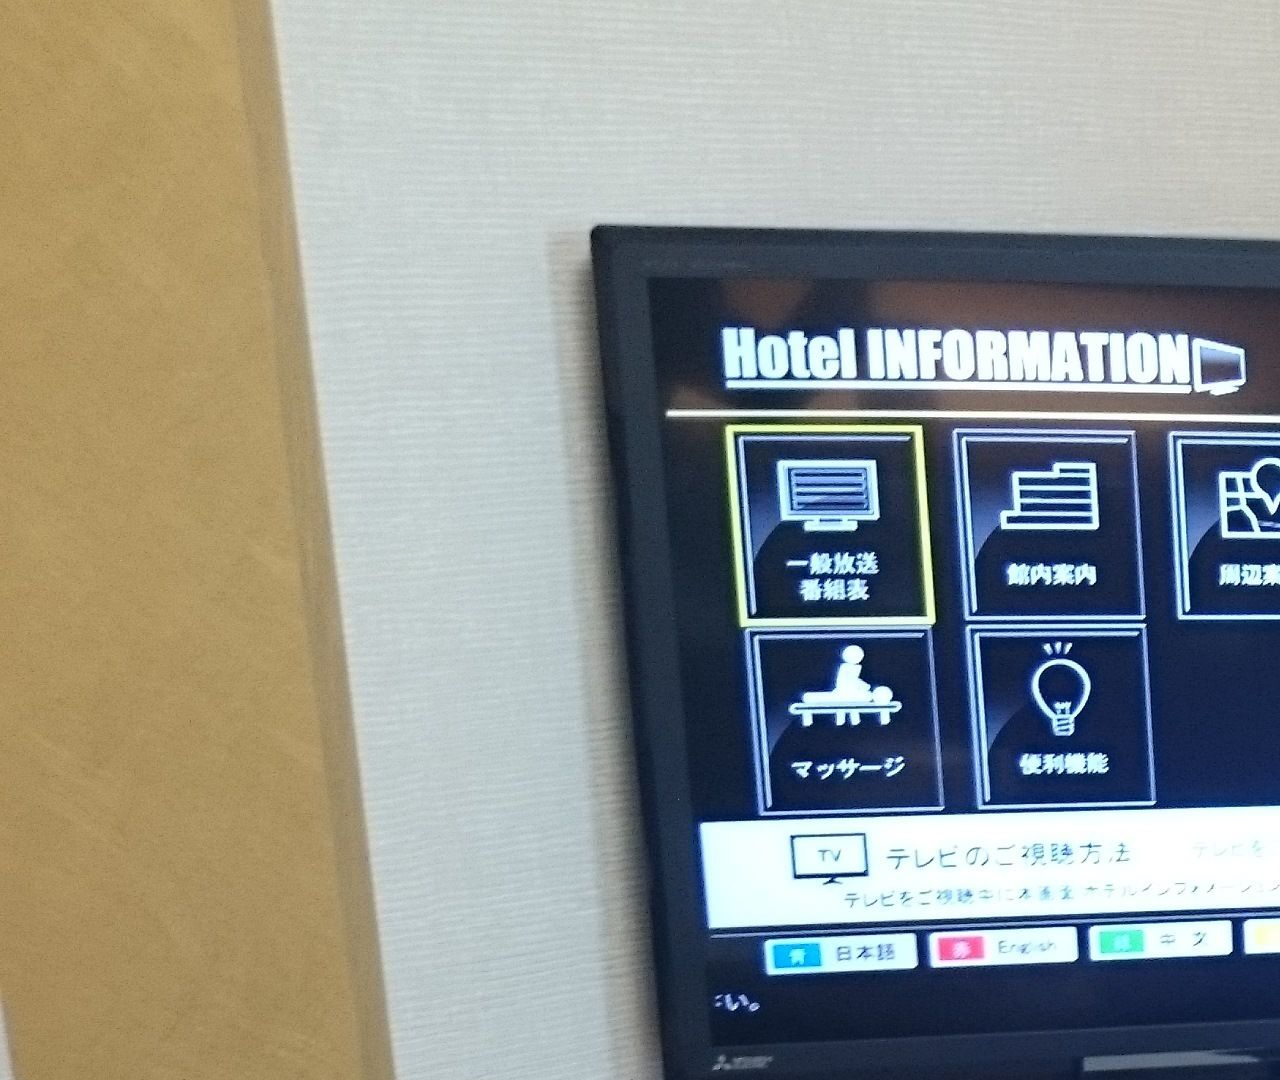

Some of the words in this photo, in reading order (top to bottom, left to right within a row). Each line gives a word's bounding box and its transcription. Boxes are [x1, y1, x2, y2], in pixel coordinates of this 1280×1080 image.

[722, 327, 857, 381] Hotel
[867, 328, 1191, 384] INFORMATION
[785, 552, 880, 576] 一般放送
[1006, 562, 1097, 586] 館内案内
[799, 578, 871, 602] 番組表
[790, 755, 906, 780] マッサージ
[1018, 752, 1110, 776] 便利機能
[817, 848, 843, 863] TV
[885, 841, 1132, 870] テレビのご視聴方法
[836, 943, 896, 962] 日本語
